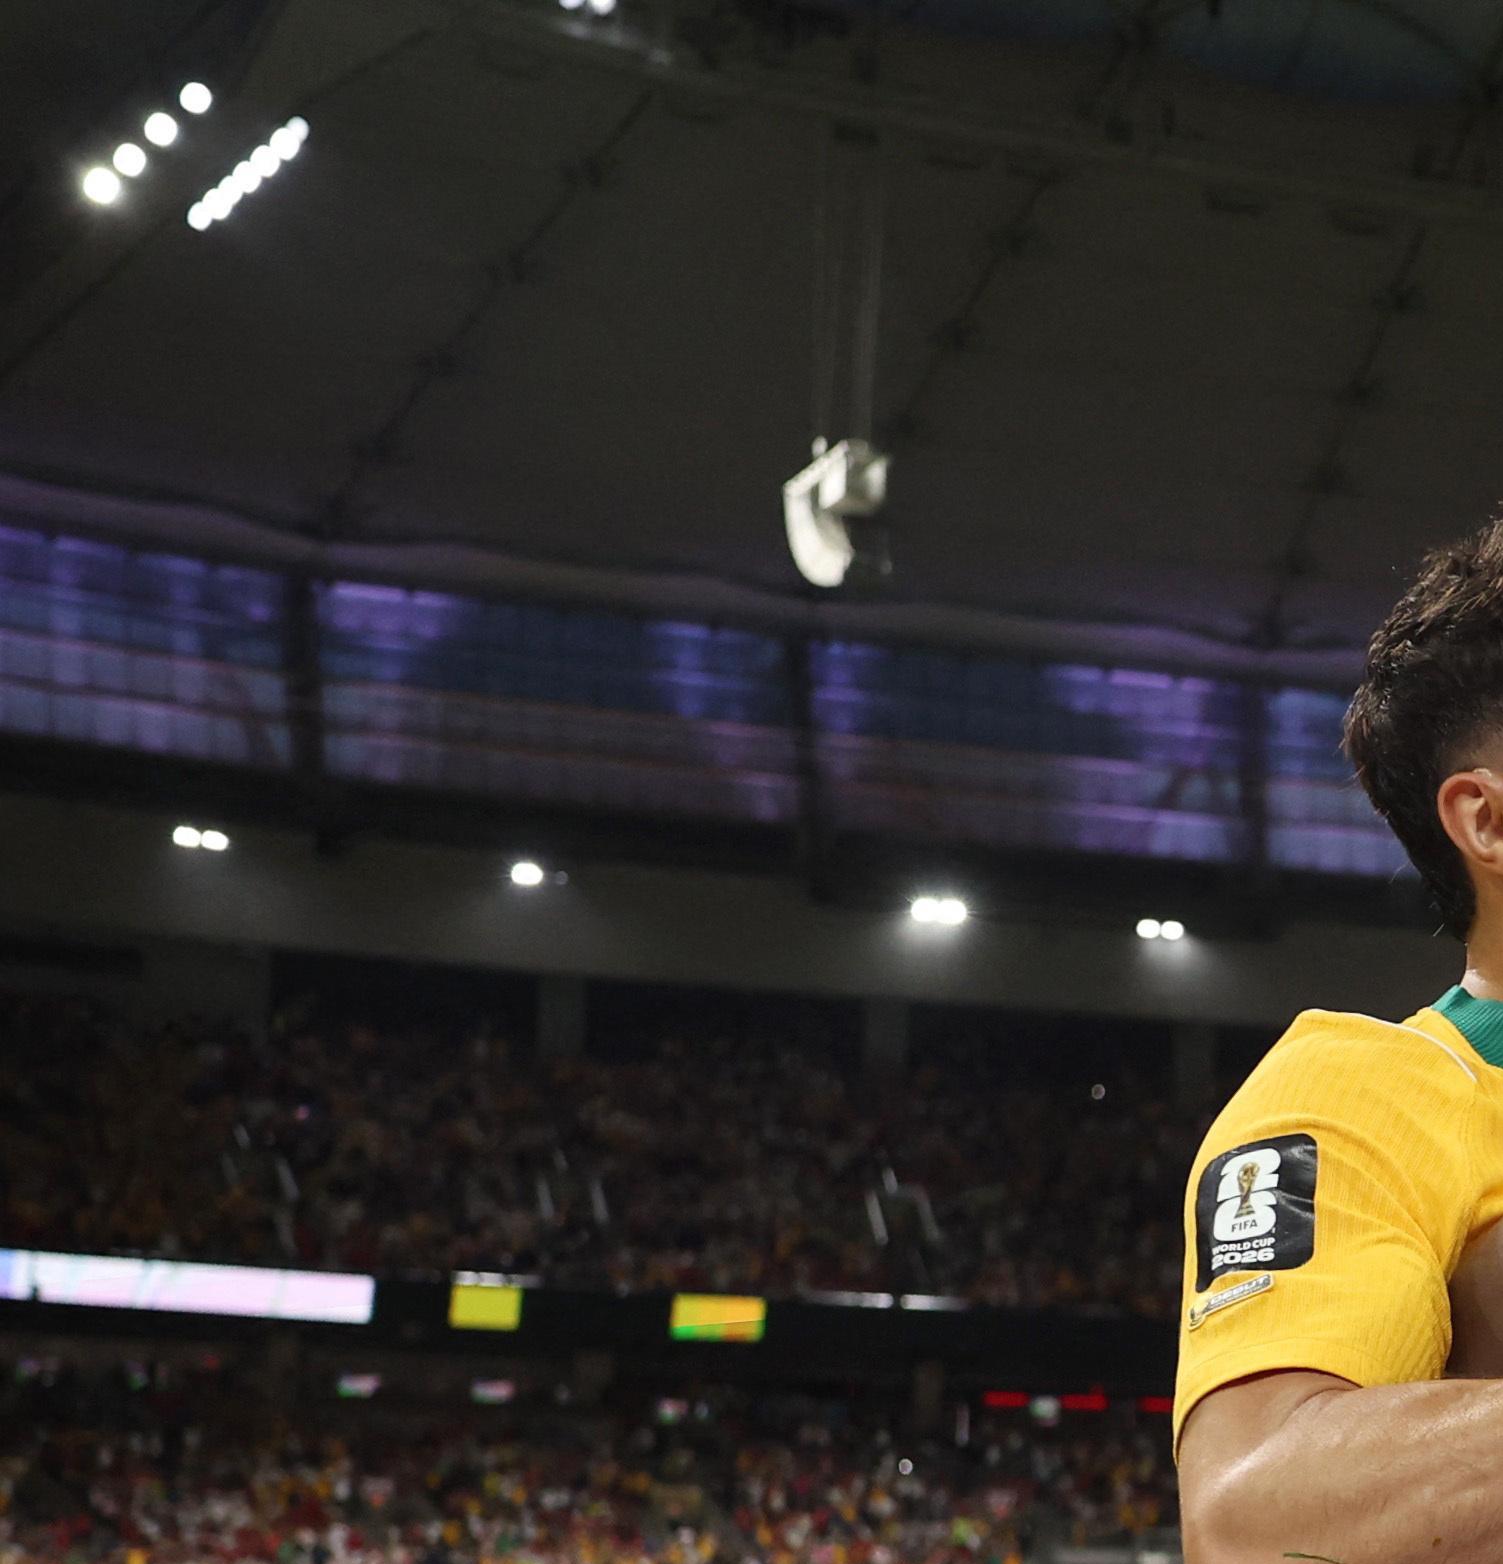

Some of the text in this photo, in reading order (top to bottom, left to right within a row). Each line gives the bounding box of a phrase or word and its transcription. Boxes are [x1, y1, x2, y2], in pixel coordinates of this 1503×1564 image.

[1231, 1220, 1259, 1234] FIFA
[1211, 1237, 1276, 1256] WORLD CUP
[1211, 1247, 1276, 1271] 2026
